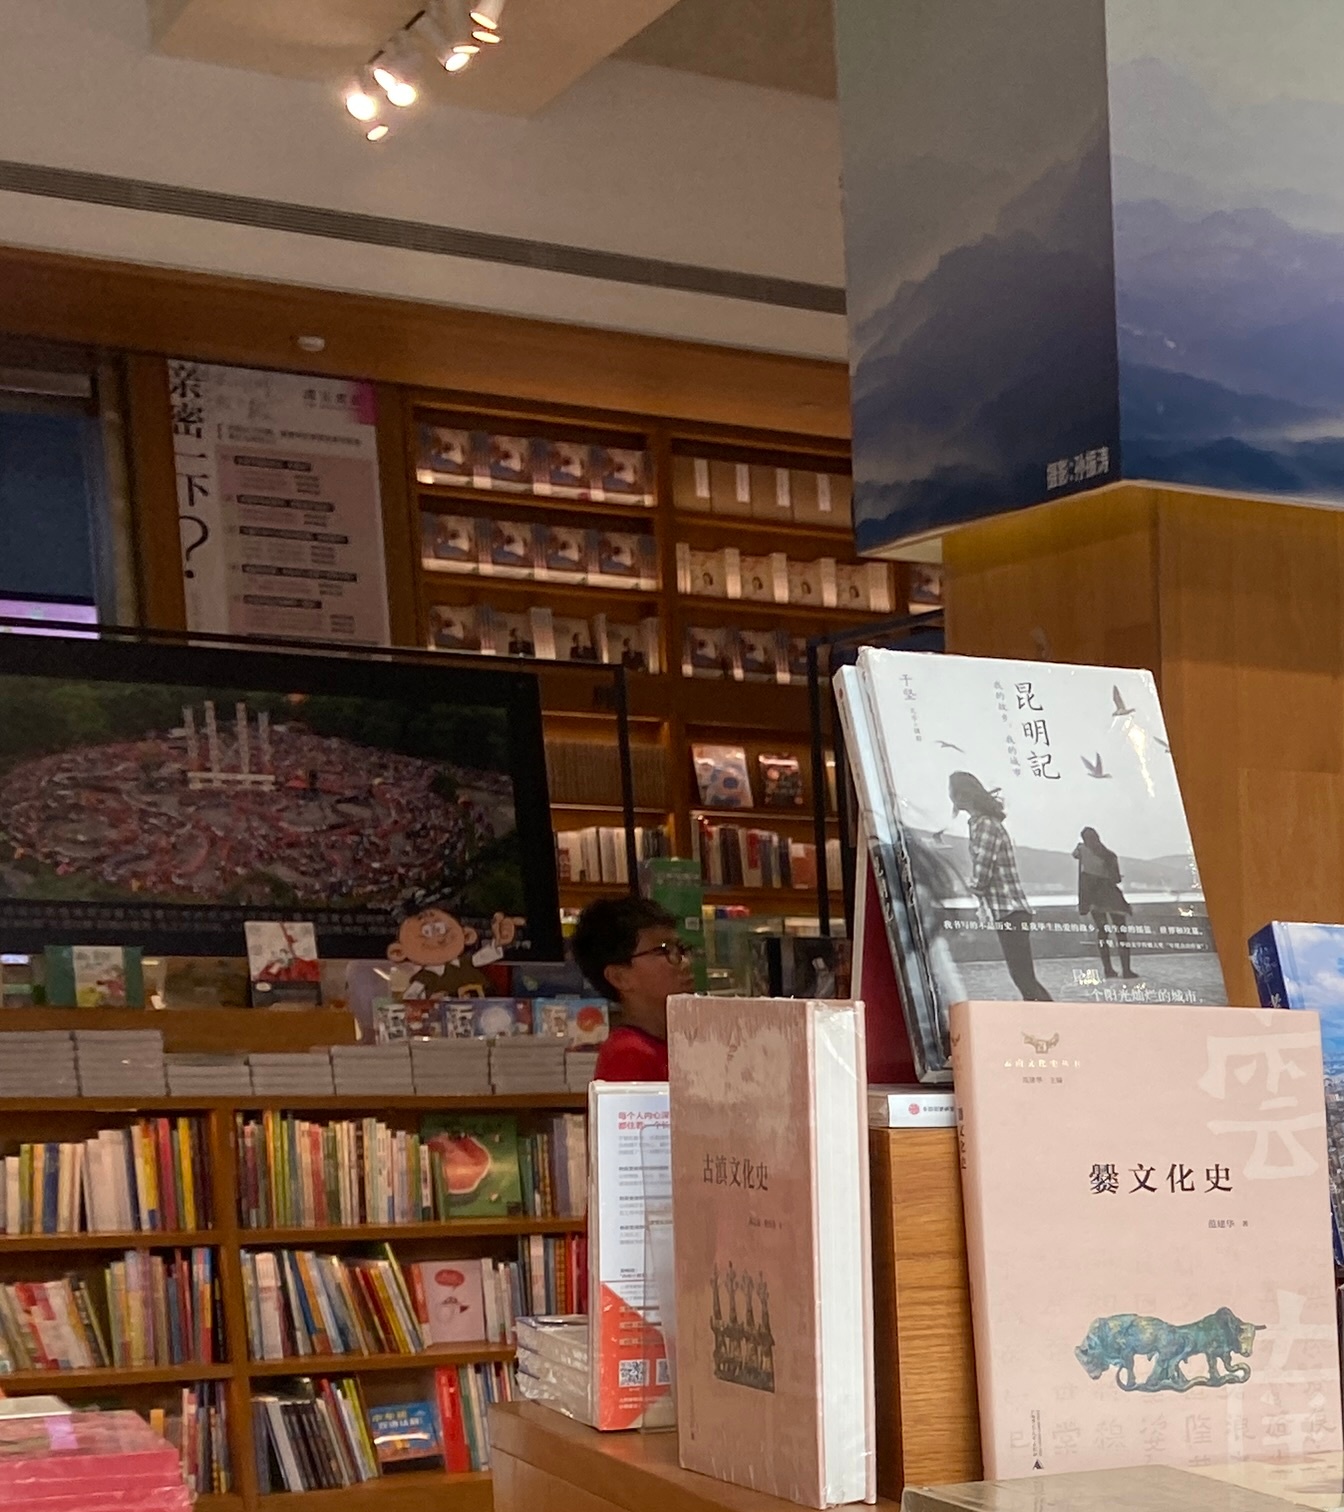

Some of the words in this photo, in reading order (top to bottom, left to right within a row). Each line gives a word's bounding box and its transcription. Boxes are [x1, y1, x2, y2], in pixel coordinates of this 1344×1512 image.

[1013, 681, 1061, 781] 昆明記
[702, 1153, 769, 1192] 古滇文化史
[1087, 1161, 1235, 1196] 爨文化史
